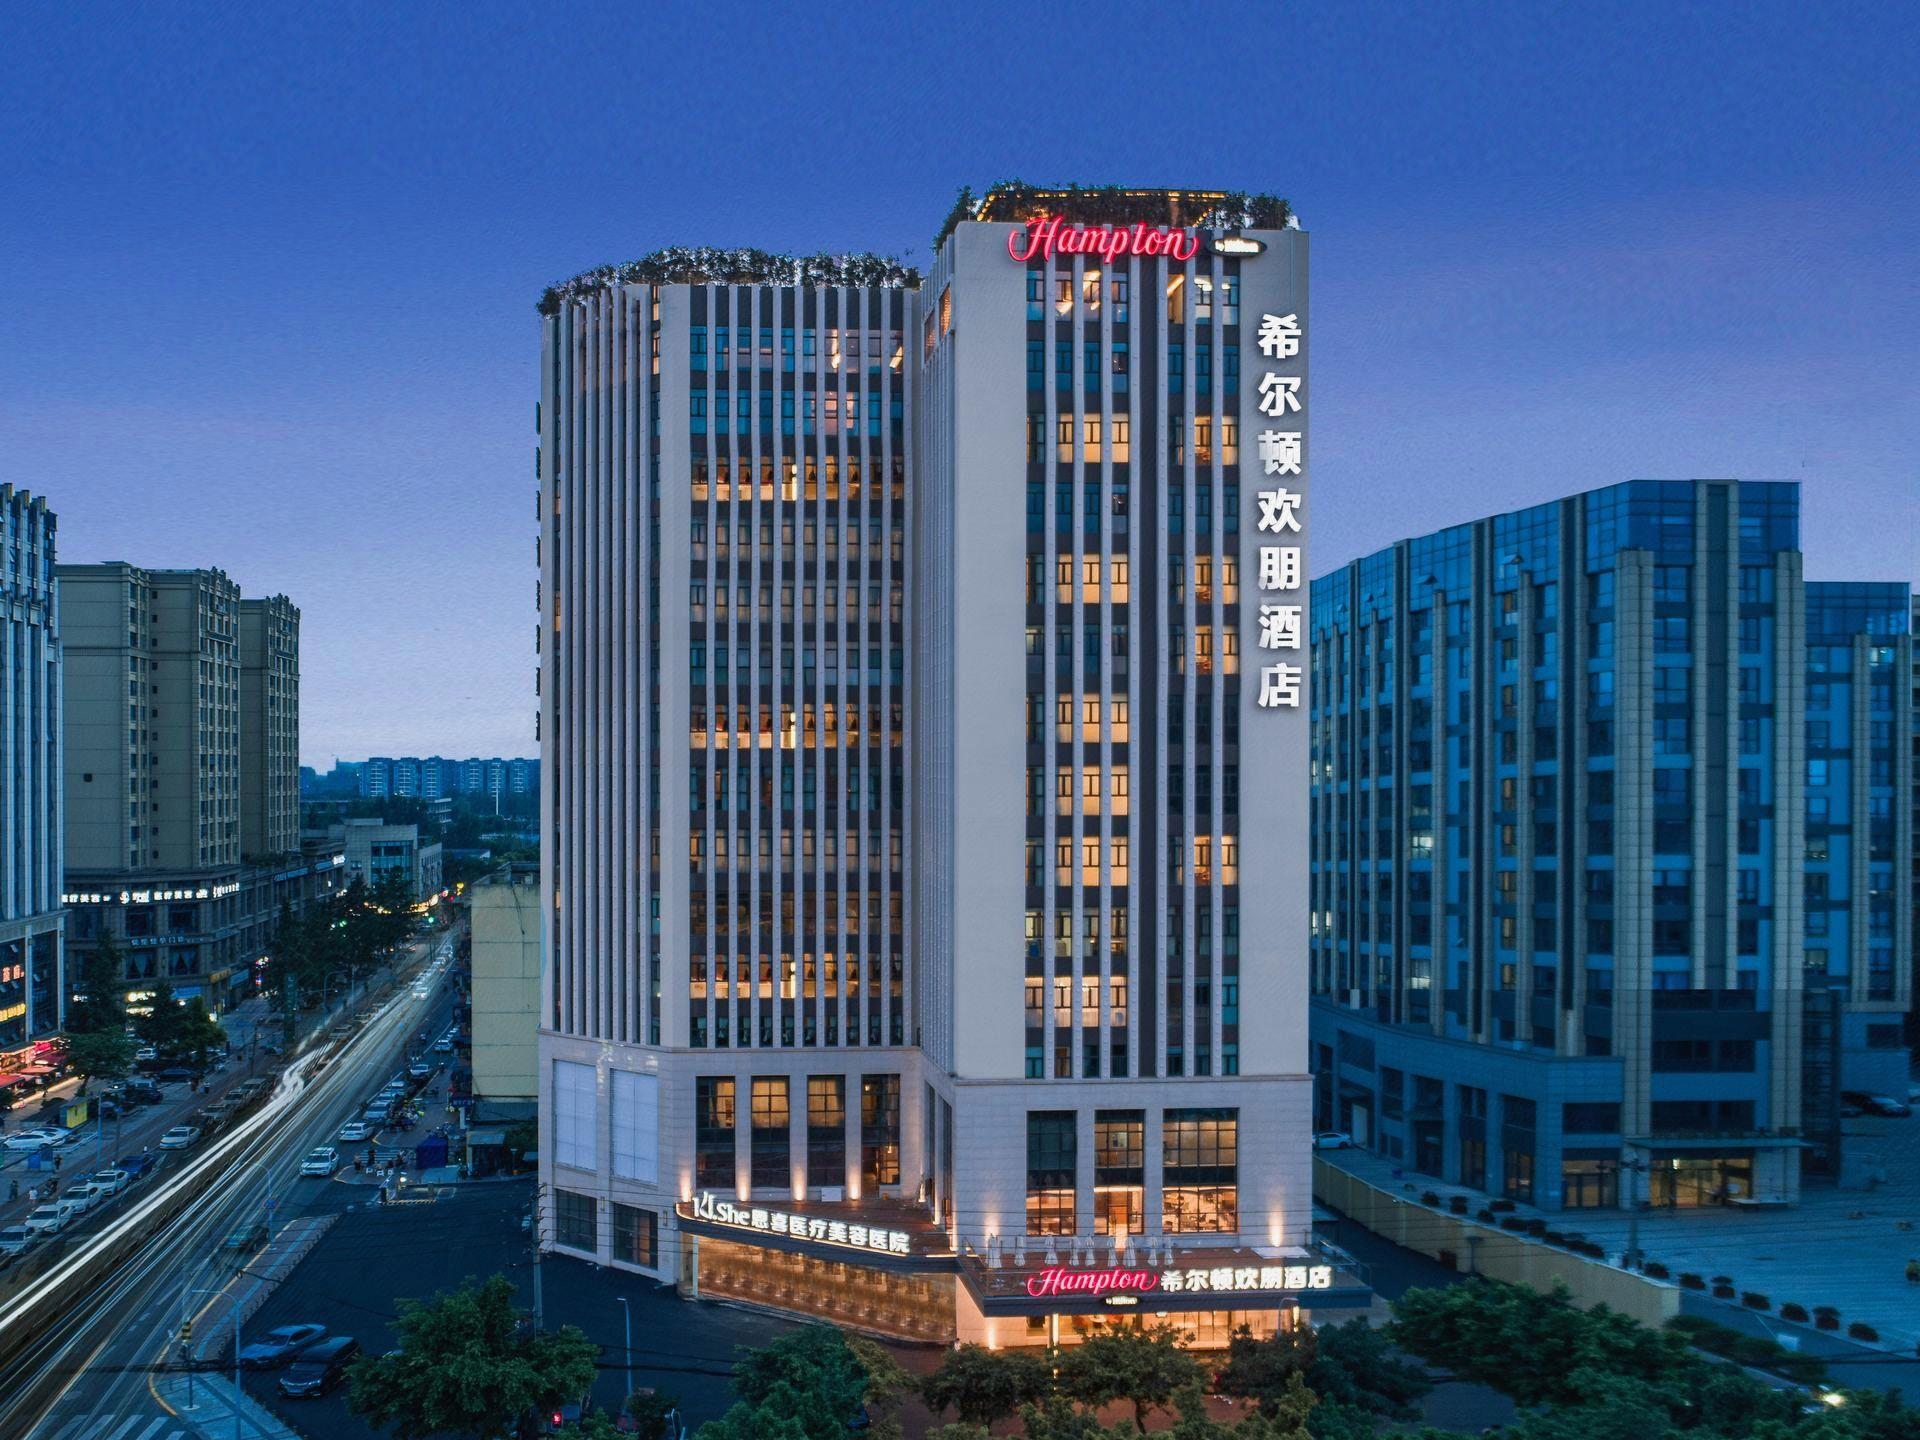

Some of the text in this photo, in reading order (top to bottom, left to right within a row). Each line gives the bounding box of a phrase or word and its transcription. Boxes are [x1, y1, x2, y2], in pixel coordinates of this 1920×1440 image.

[1008, 215, 1199, 264] Hampton
[1257, 313, 1302, 708] 希尔顿欢朋酒店
[1027, 1267, 1159, 1297] Hampton
[1160, 1265, 1332, 1292] 希尔顿欢朋酒店
